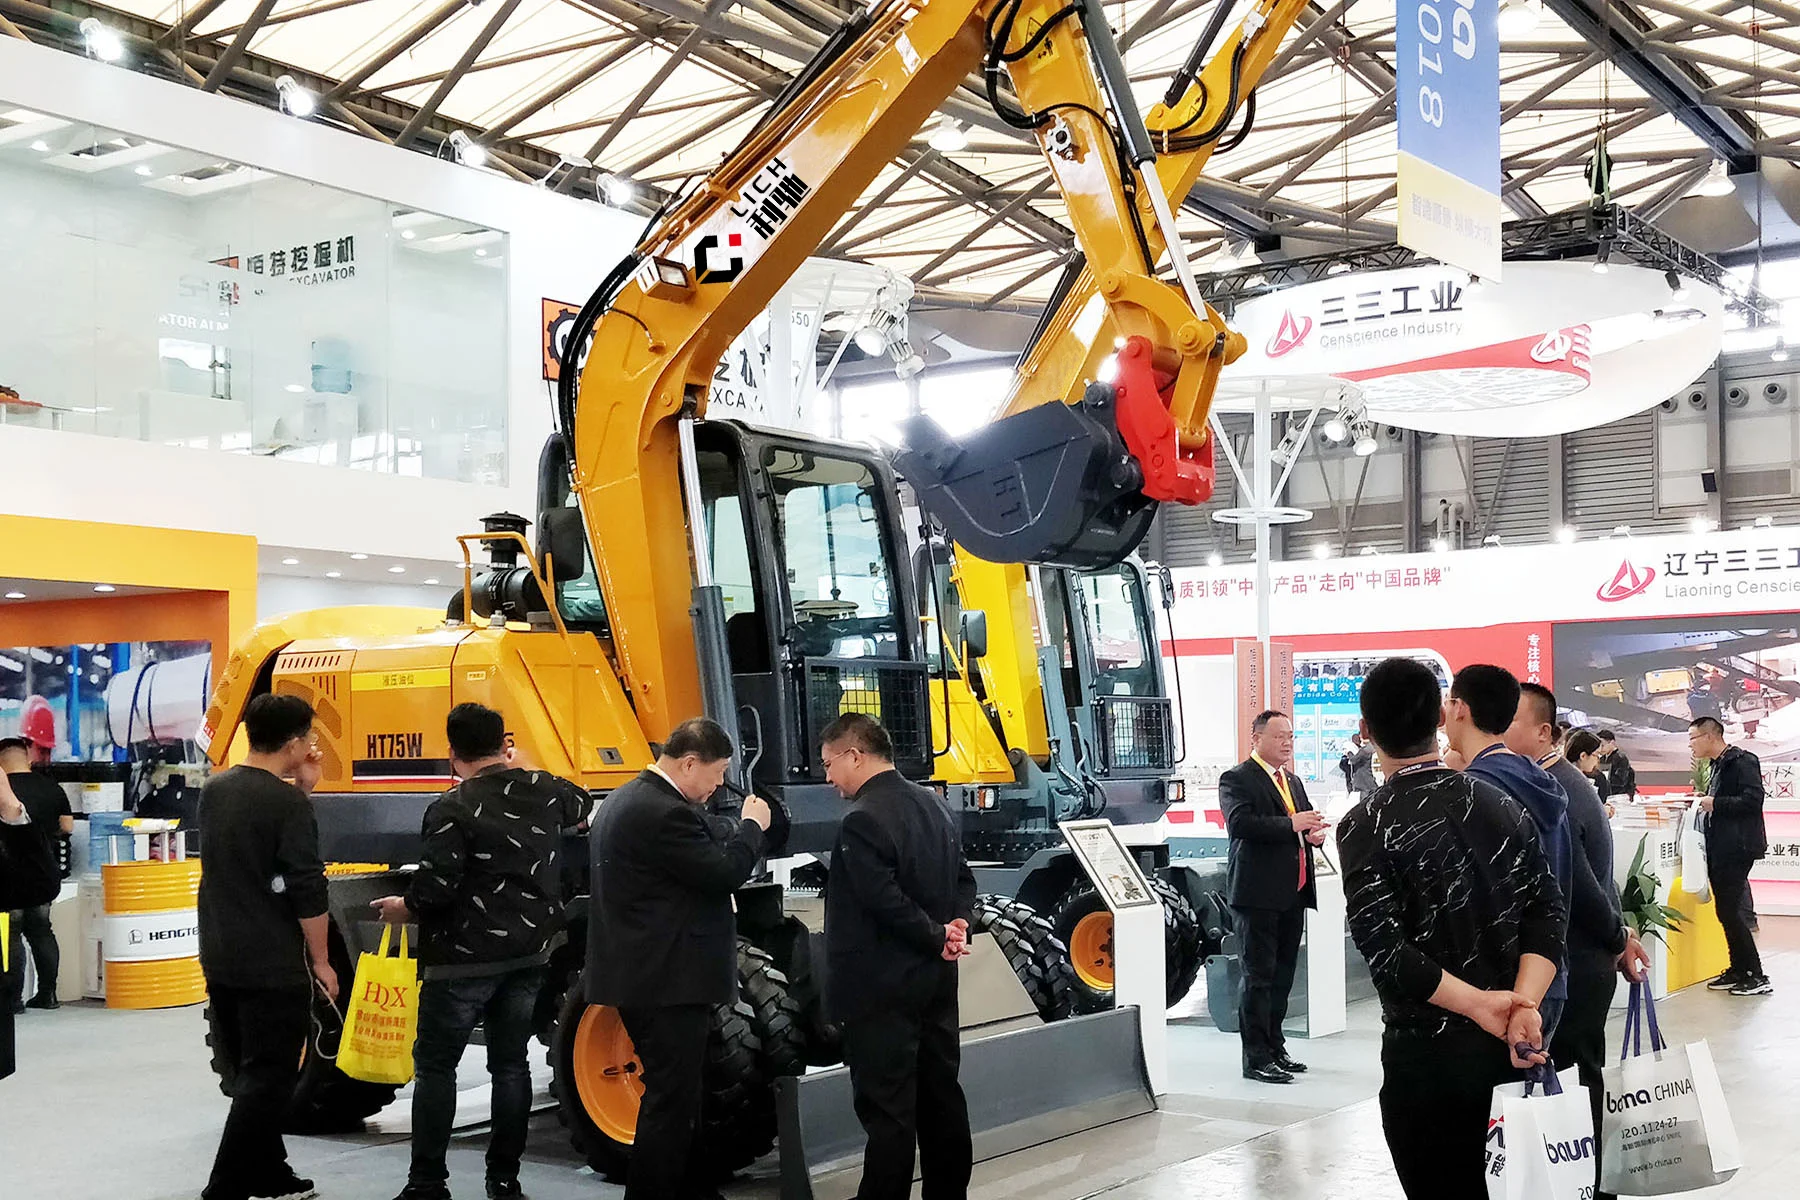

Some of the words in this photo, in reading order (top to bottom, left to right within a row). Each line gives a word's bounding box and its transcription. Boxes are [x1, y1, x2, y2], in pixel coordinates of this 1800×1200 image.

[1418, 0, 1444, 128] 018
[730, 157, 787, 217] LICH
[1320, 281, 1463, 326] 三三工业
[1320, 326, 1399, 348] Censcience
[1403, 320, 1463, 336] Industry
[1665, 583, 1732, 599] Liaoning
[367, 733, 422, 758] HT75W
[363, 981, 408, 1012] HQX
[1654, 1078, 1694, 1101] CHINA
